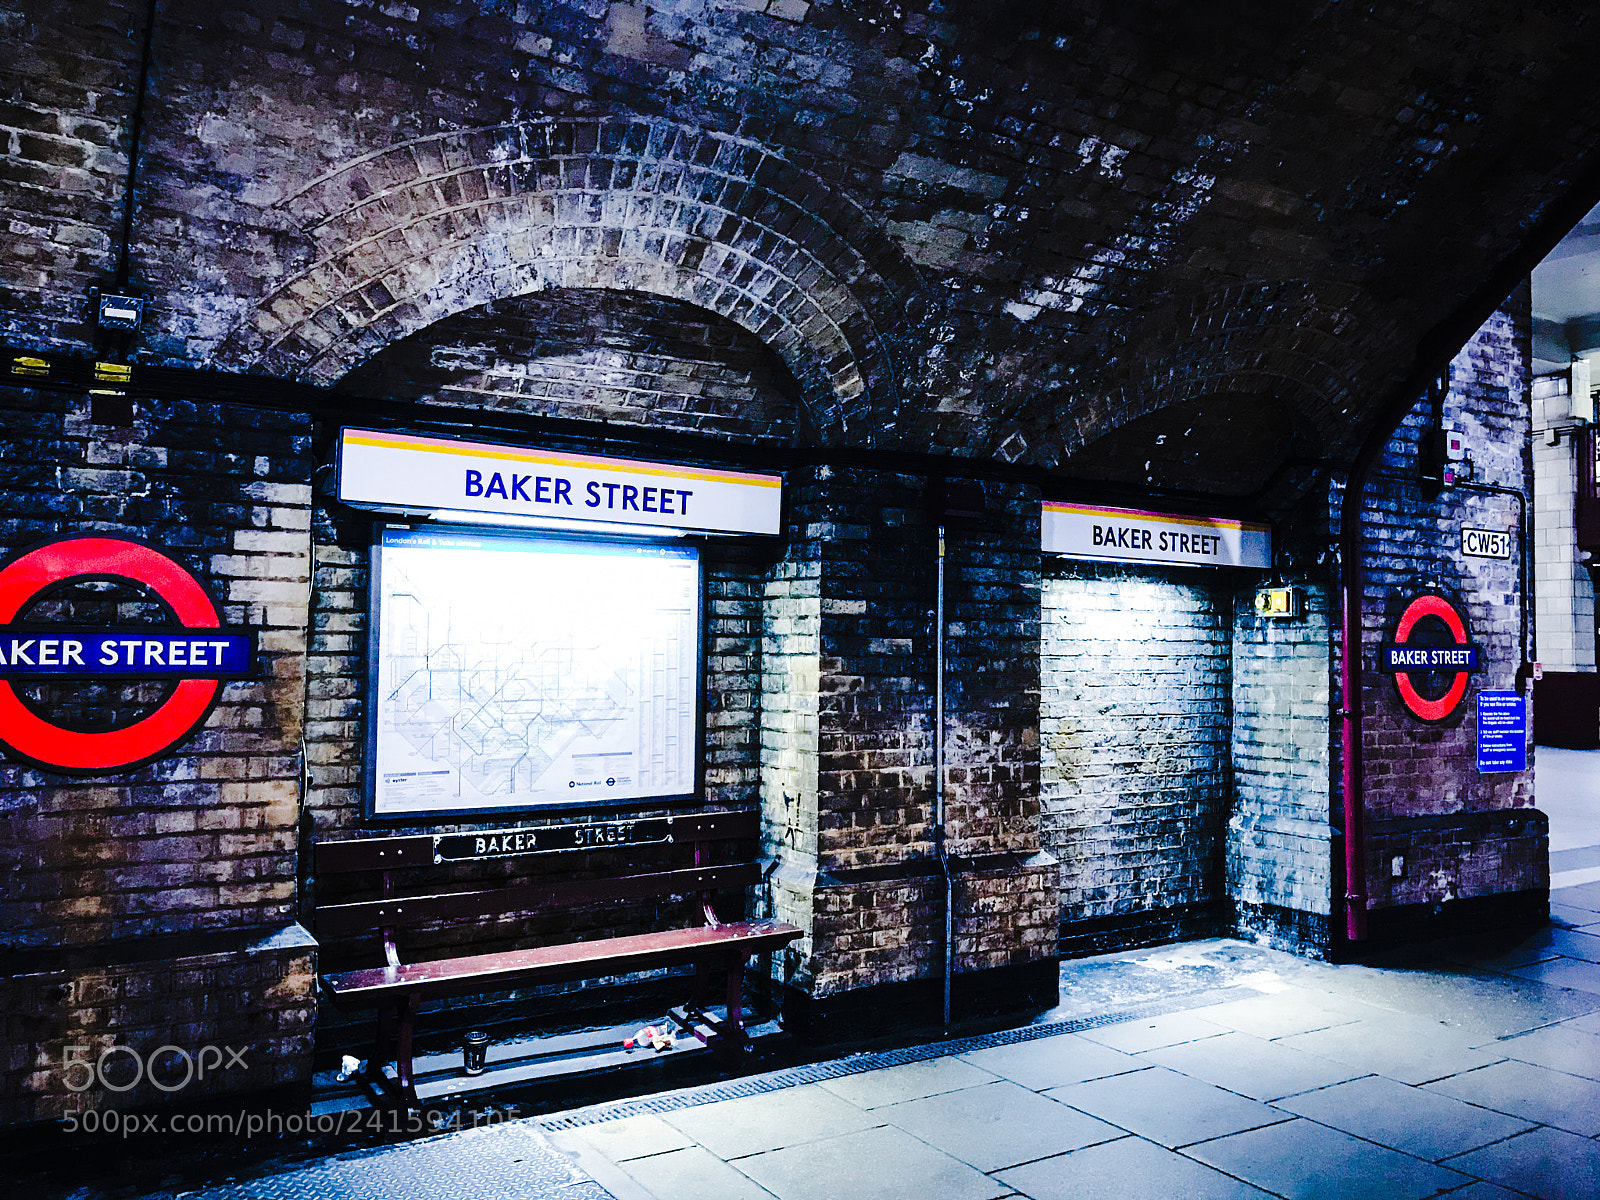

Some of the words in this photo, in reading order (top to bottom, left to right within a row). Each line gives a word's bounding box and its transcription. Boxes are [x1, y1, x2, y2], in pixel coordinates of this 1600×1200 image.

[465, 469, 573, 506] BAKER
[585, 481, 694, 516] STREET
[1092, 524, 1153, 550] BAKER
[1159, 530, 1221, 556] STREET
[1467, 531, 1507, 555] CW51
[99, 639, 230, 666] STREET
[1391, 650, 1429, 665] BAKER
[1431, 650, 1471, 665] STREET
[475, 833, 538, 854] BAKER
[574, 825, 636, 845] STREET
